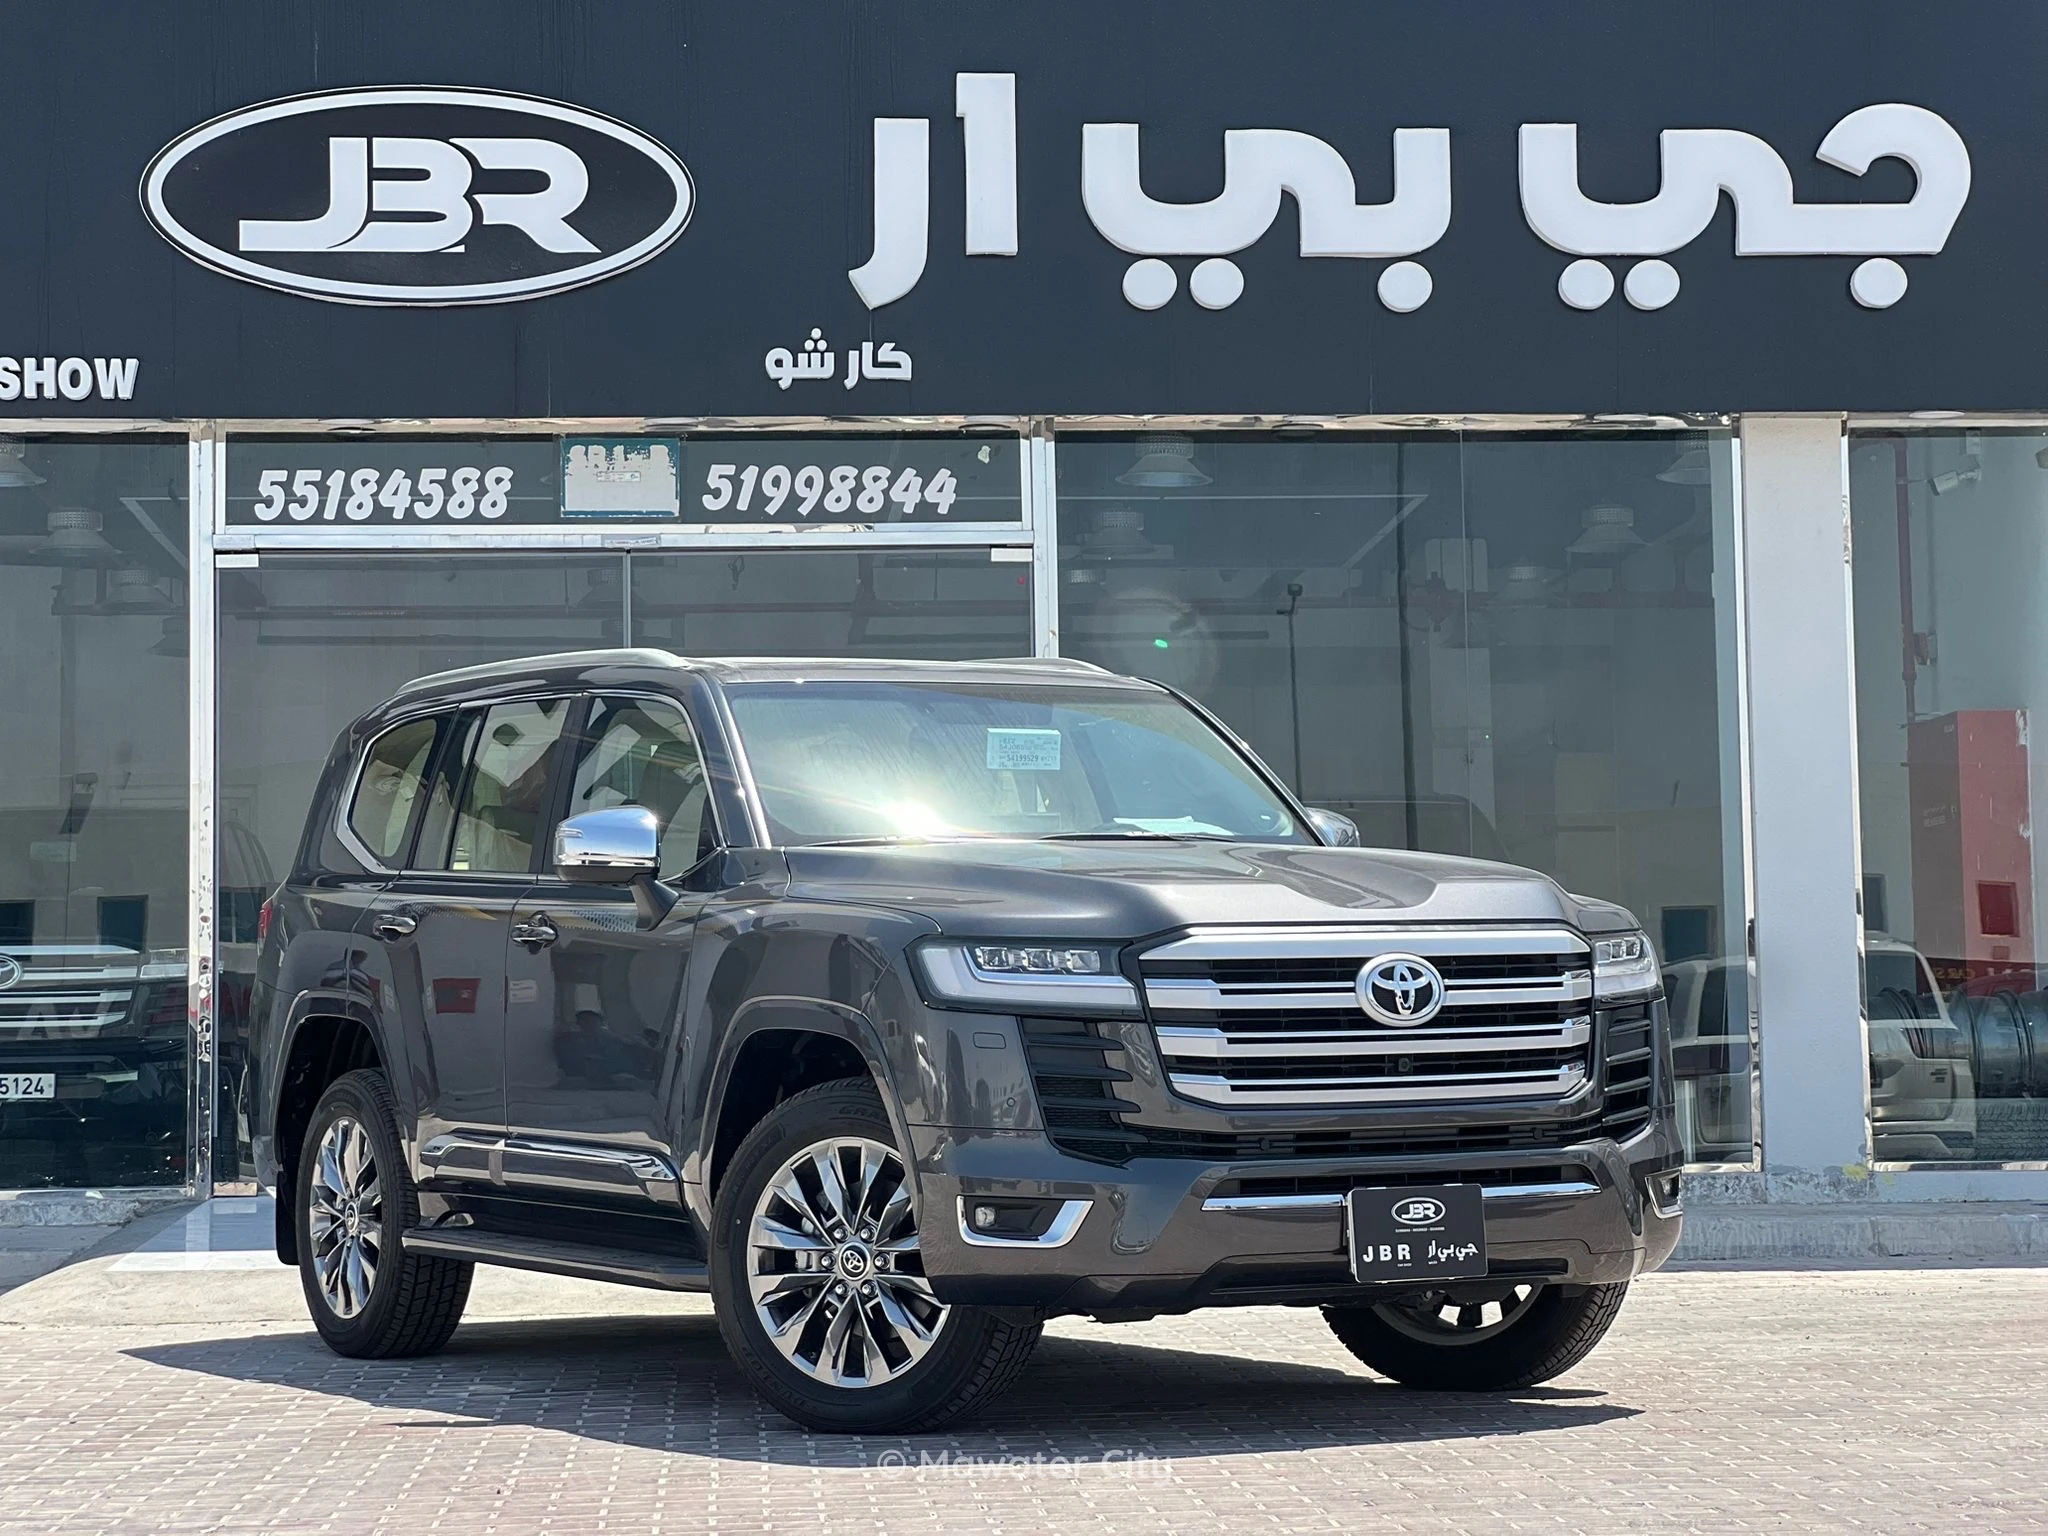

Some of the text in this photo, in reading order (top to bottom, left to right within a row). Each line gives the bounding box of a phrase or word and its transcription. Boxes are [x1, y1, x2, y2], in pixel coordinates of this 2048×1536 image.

[238, 136, 602, 254] JBR
[0, 356, 140, 401] SHOW
[765, 327, 912, 390] كار شو
[253, 466, 514, 521] 55184588
[701, 464, 958, 517] 51998844
[0, 1077, 45, 1095] 5124
[1401, 1202, 1436, 1219] JBR
